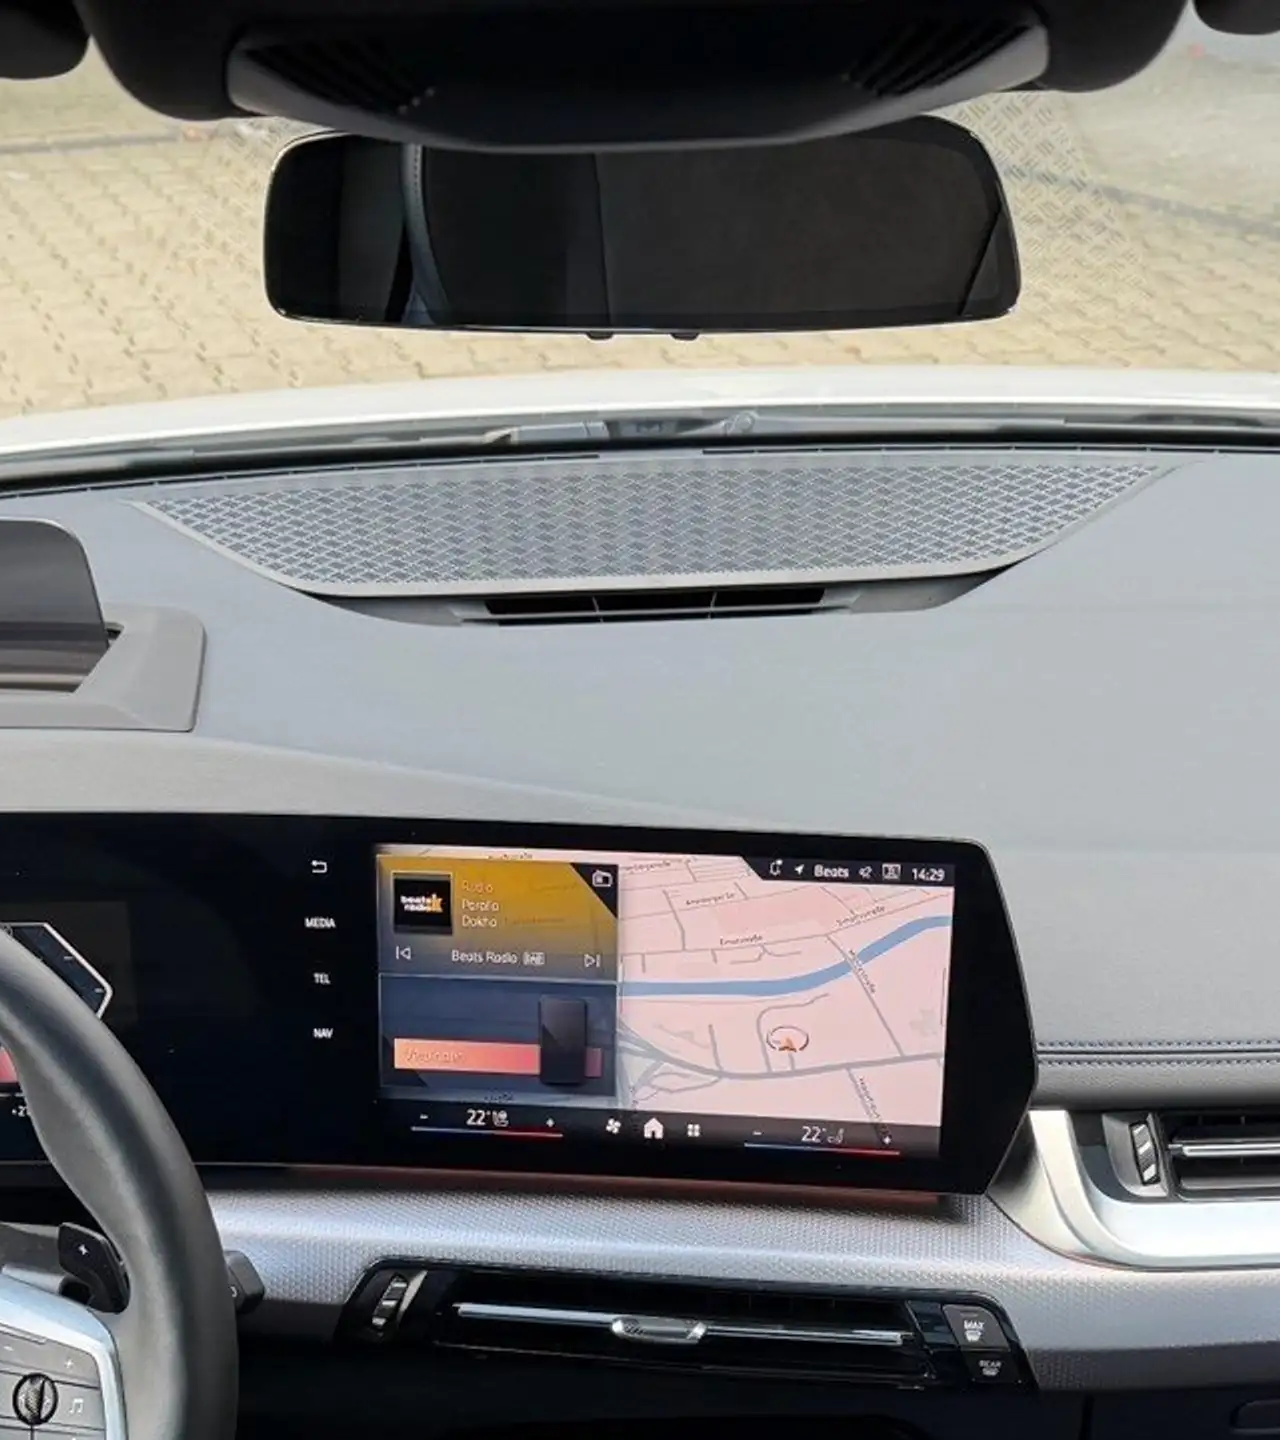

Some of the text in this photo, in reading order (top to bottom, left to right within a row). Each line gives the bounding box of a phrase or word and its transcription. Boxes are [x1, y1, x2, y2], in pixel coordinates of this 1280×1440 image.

[814, 864, 849, 878] Beats
[911, 867, 945, 882] 14:29
[304, 917, 336, 928] MEDIA
[452, 949, 484, 963] Beats
[486, 951, 517, 965] Radio
[313, 972, 331, 985] TEL
[313, 1028, 333, 1039] NAV
[963, 1319, 985, 1330] MAX
